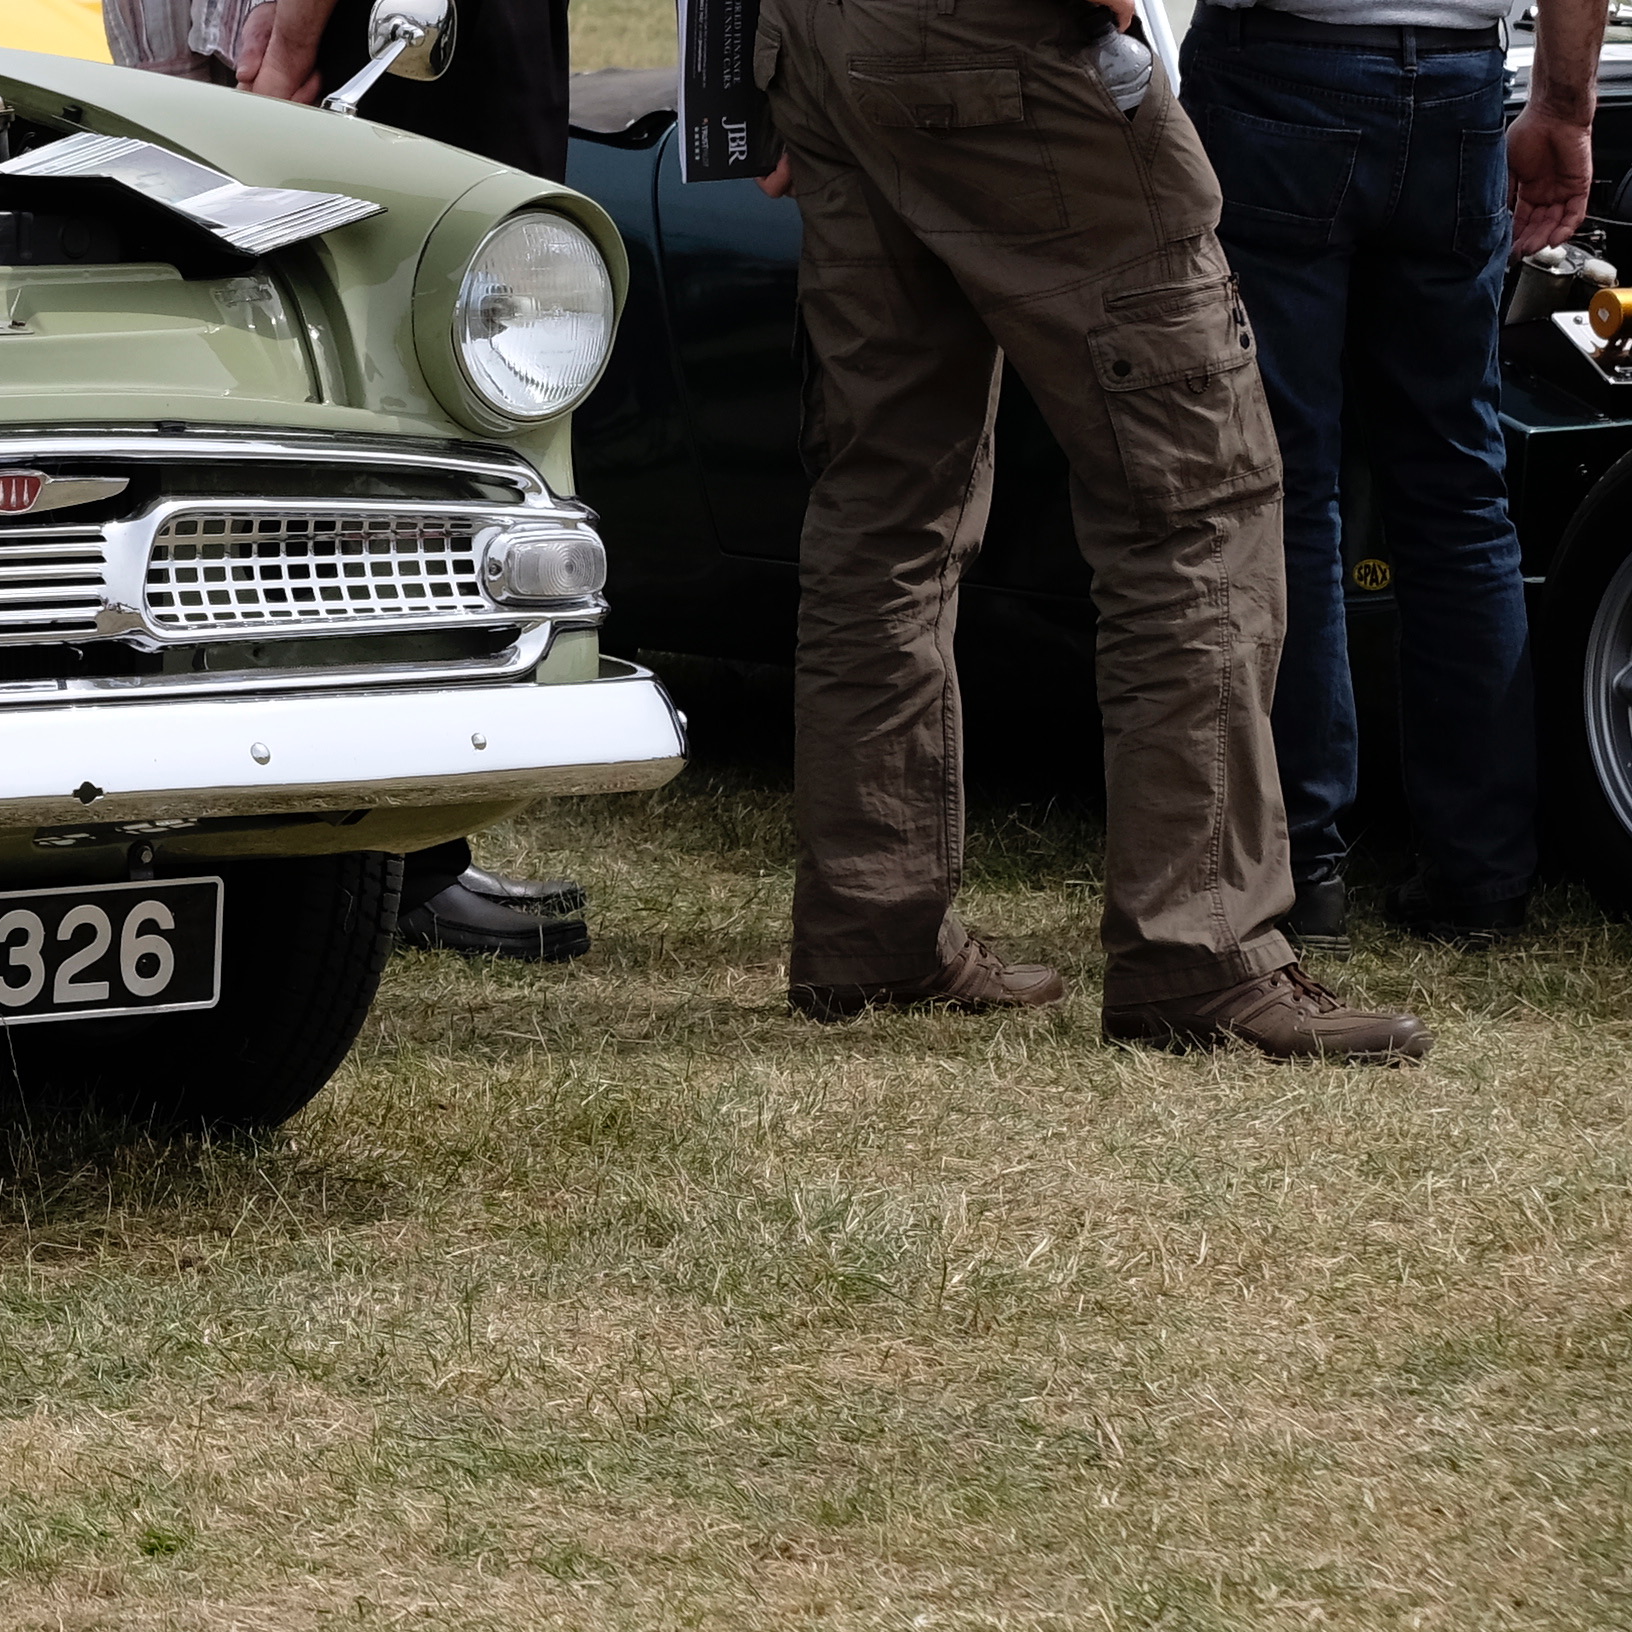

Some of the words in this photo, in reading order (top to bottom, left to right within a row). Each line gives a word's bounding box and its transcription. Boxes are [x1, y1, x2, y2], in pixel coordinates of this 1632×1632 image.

[722, 58, 732, 90] CARS
[733, 33, 742, 84] FINANCE
[721, 116, 748, 166] JBR
[1356, 562, 1388, 586] SPAX
